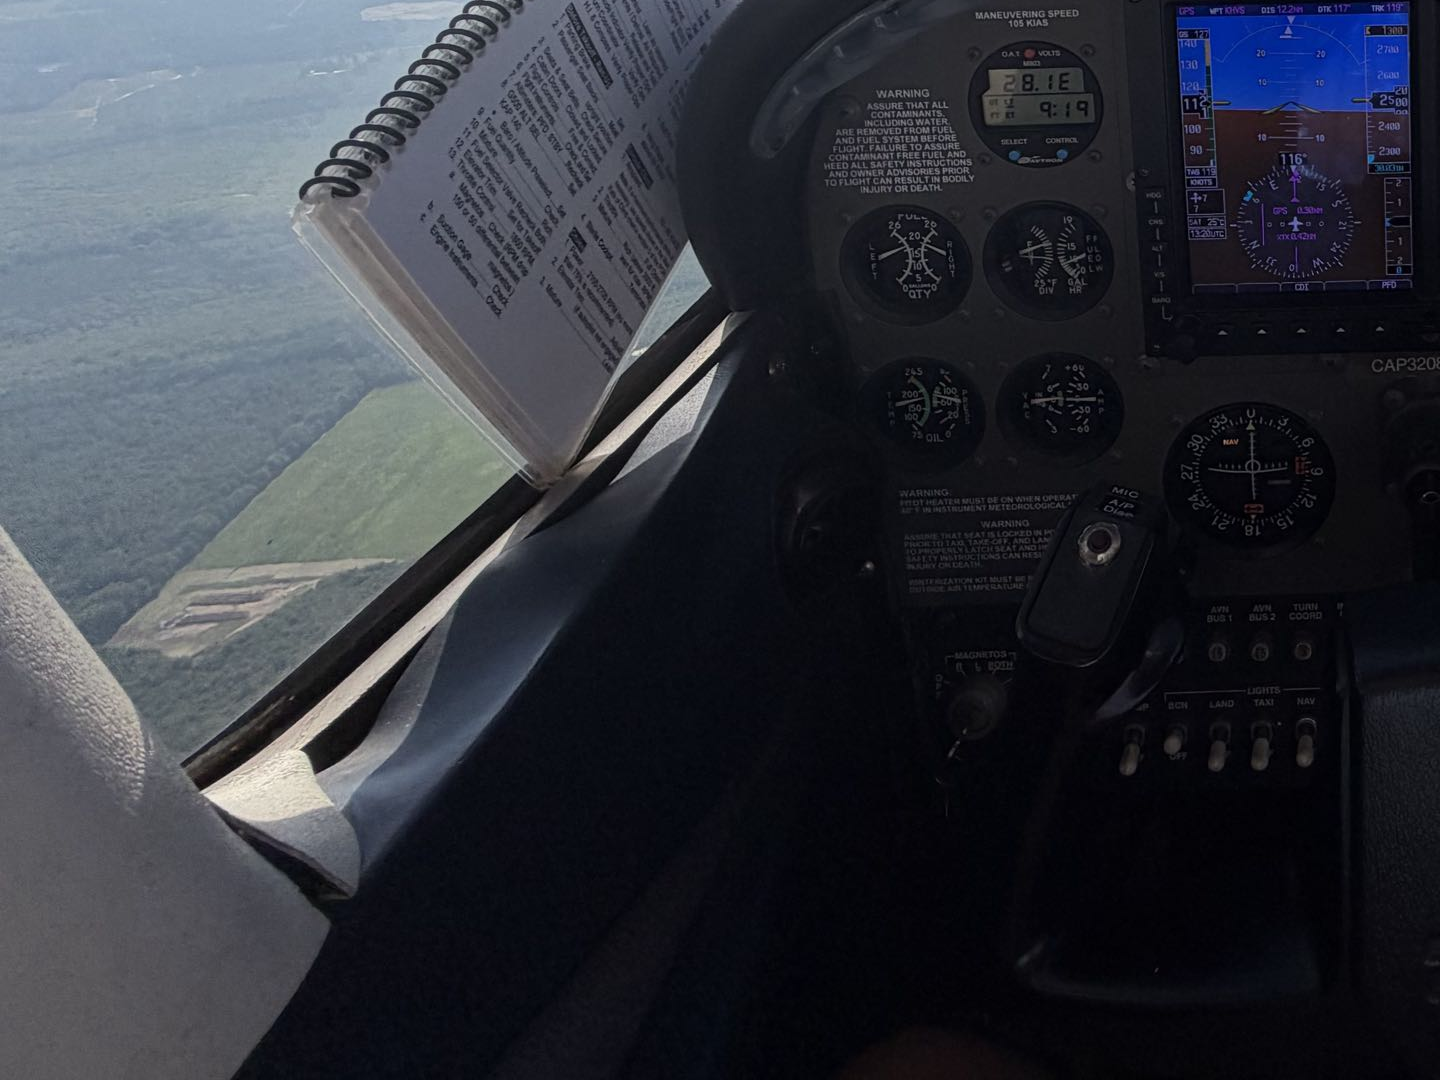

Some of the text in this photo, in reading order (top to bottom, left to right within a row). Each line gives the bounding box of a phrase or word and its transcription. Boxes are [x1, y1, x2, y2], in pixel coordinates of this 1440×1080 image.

[975, 9, 1079, 19] MANEUVERING SPEED
[1027, 19, 1048, 27] KIAS
[876, 89, 930, 98] WARNING
[906, 101, 929, 109] THAT
[932, 101, 949, 109] ALL
[1040, 100, 1088, 118] 9:19
[865, 119, 913, 127] INCLUDING
[1378, 122, 1400, 131] 2400
[921, 134, 957, 142] BEFORE
[494, 133, 516, 165] Quantity
[1379, 147, 1401, 155] 2300
[829, 153, 894, 161] CONTAMINANT
[947, 150, 966, 158] AND
[1280, 153, 1307, 164] 116°
[870, 160, 905, 168] SAFETY
[907, 159, 972, 167] INSTRUCTIONS
[887, 168, 940, 176] ADVISORIES
[861, 185, 892, 193] INJURY
[430, 224, 450, 252] Engine
[1111, 485, 1140, 499] MIC
[1247, 686, 1280, 695] LIGHTS
[1209, 700, 1234, 708] LAND
